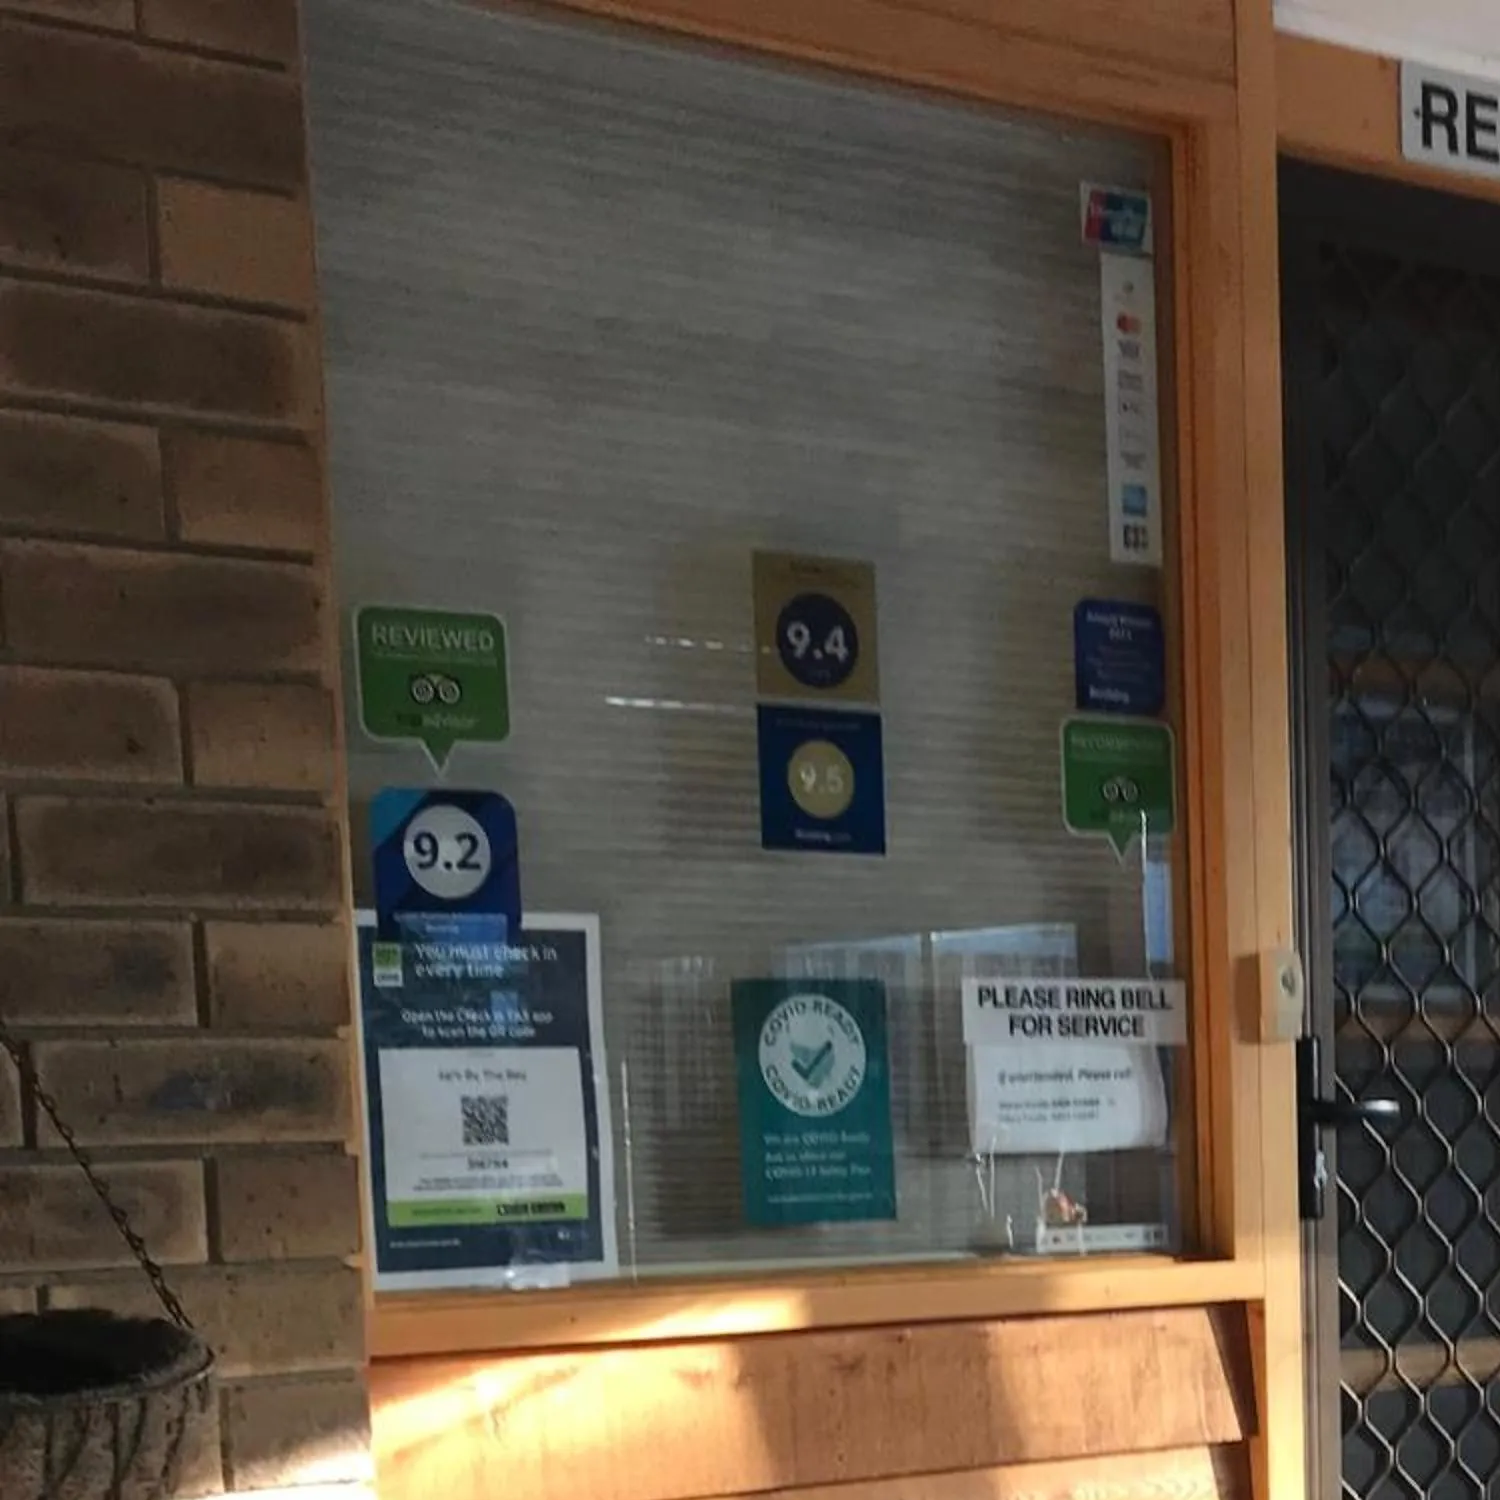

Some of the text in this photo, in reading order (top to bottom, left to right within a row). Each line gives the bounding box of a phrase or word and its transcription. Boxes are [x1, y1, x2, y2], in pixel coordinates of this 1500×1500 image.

[371, 621, 495, 653] REVIEWED
[786, 620, 850, 664] 9.4
[798, 760, 845, 796] 9.5
[412, 830, 482, 872] 9.2
[414, 943, 442, 961] You
[449, 943, 489, 961] must
[494, 944, 541, 962] check
[415, 962, 466, 979] every
[467, 962, 505, 979] time
[977, 985, 1174, 1011] PLEASE RING BELL
[764, 1000, 860, 1047] COVID READY
[1008, 1013, 1145, 1038] FOR SERVICE
[764, 1064, 861, 1112] COVID READY
